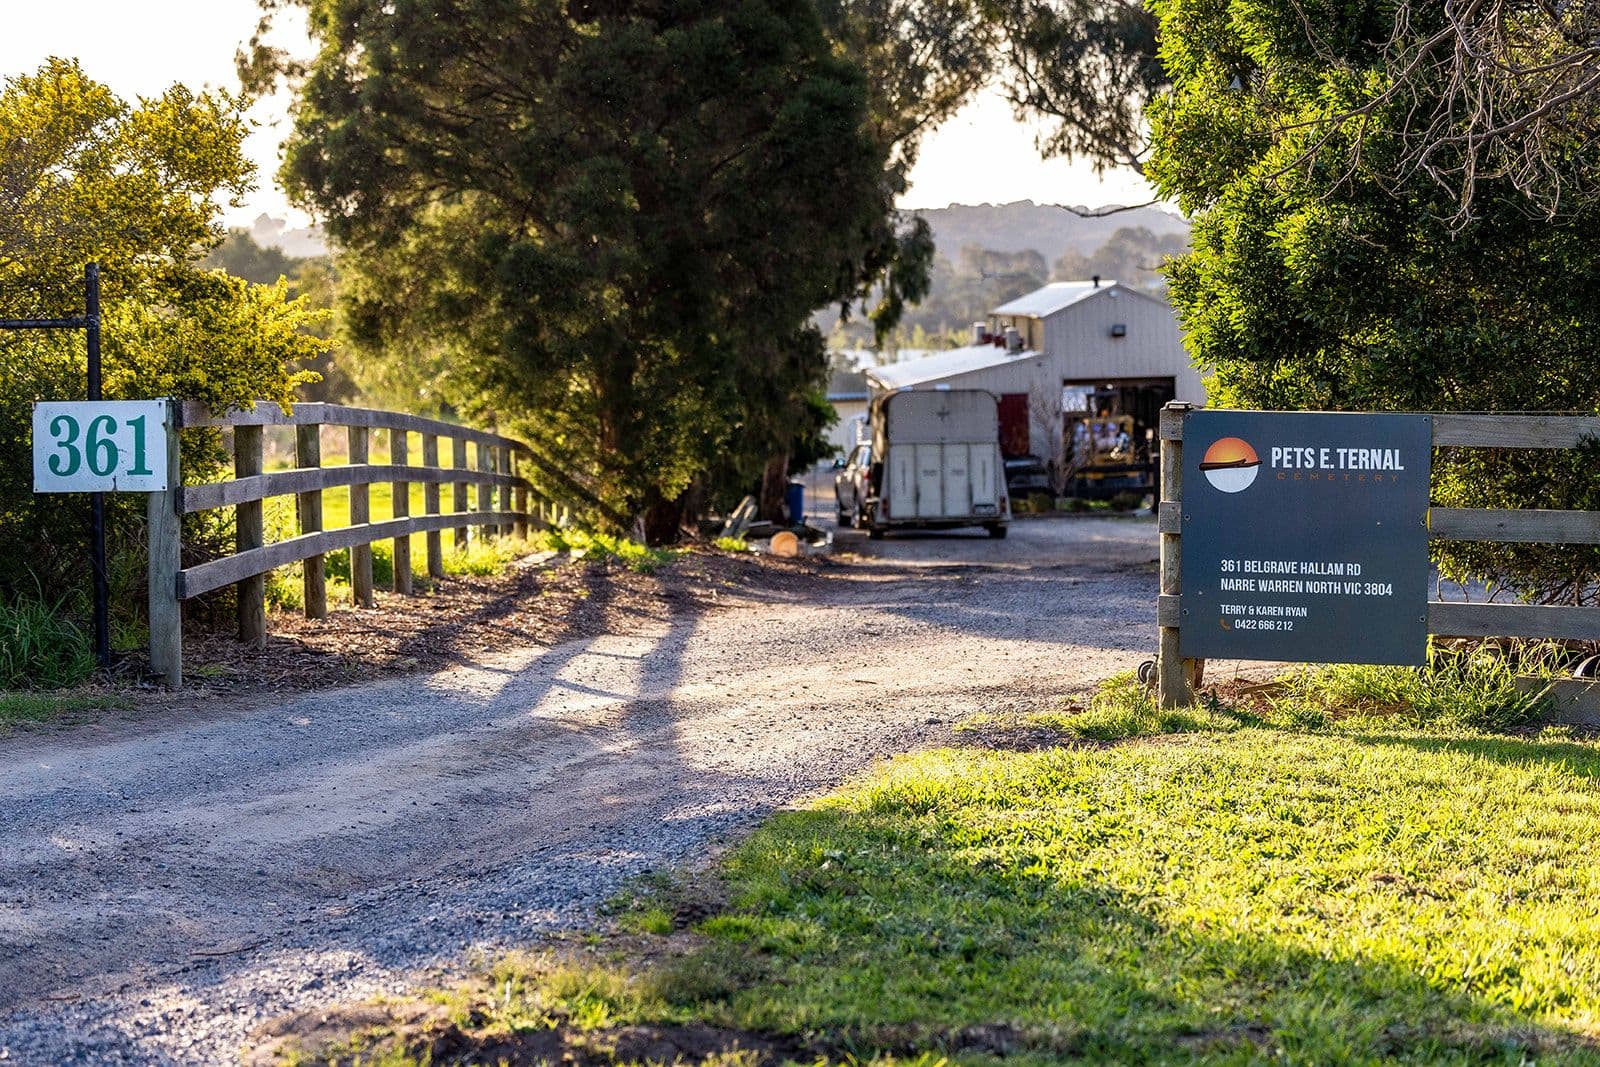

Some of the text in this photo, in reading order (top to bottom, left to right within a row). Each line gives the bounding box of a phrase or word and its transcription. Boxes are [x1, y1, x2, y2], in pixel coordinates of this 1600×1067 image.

[48, 414, 153, 477] 361
[1271, 446, 1315, 469] PETS
[1276, 472, 1399, 481] CEMETERY
[1220, 559, 1361, 576] 361 BELGRAVE HALLAM RD
[1220, 578, 1393, 596] NARRE WARREN NORTH VIC 3804
[1220, 604, 1308, 617] TERRY & KAREN RYAN
[1234, 619, 1293, 631] 0422 666 212
